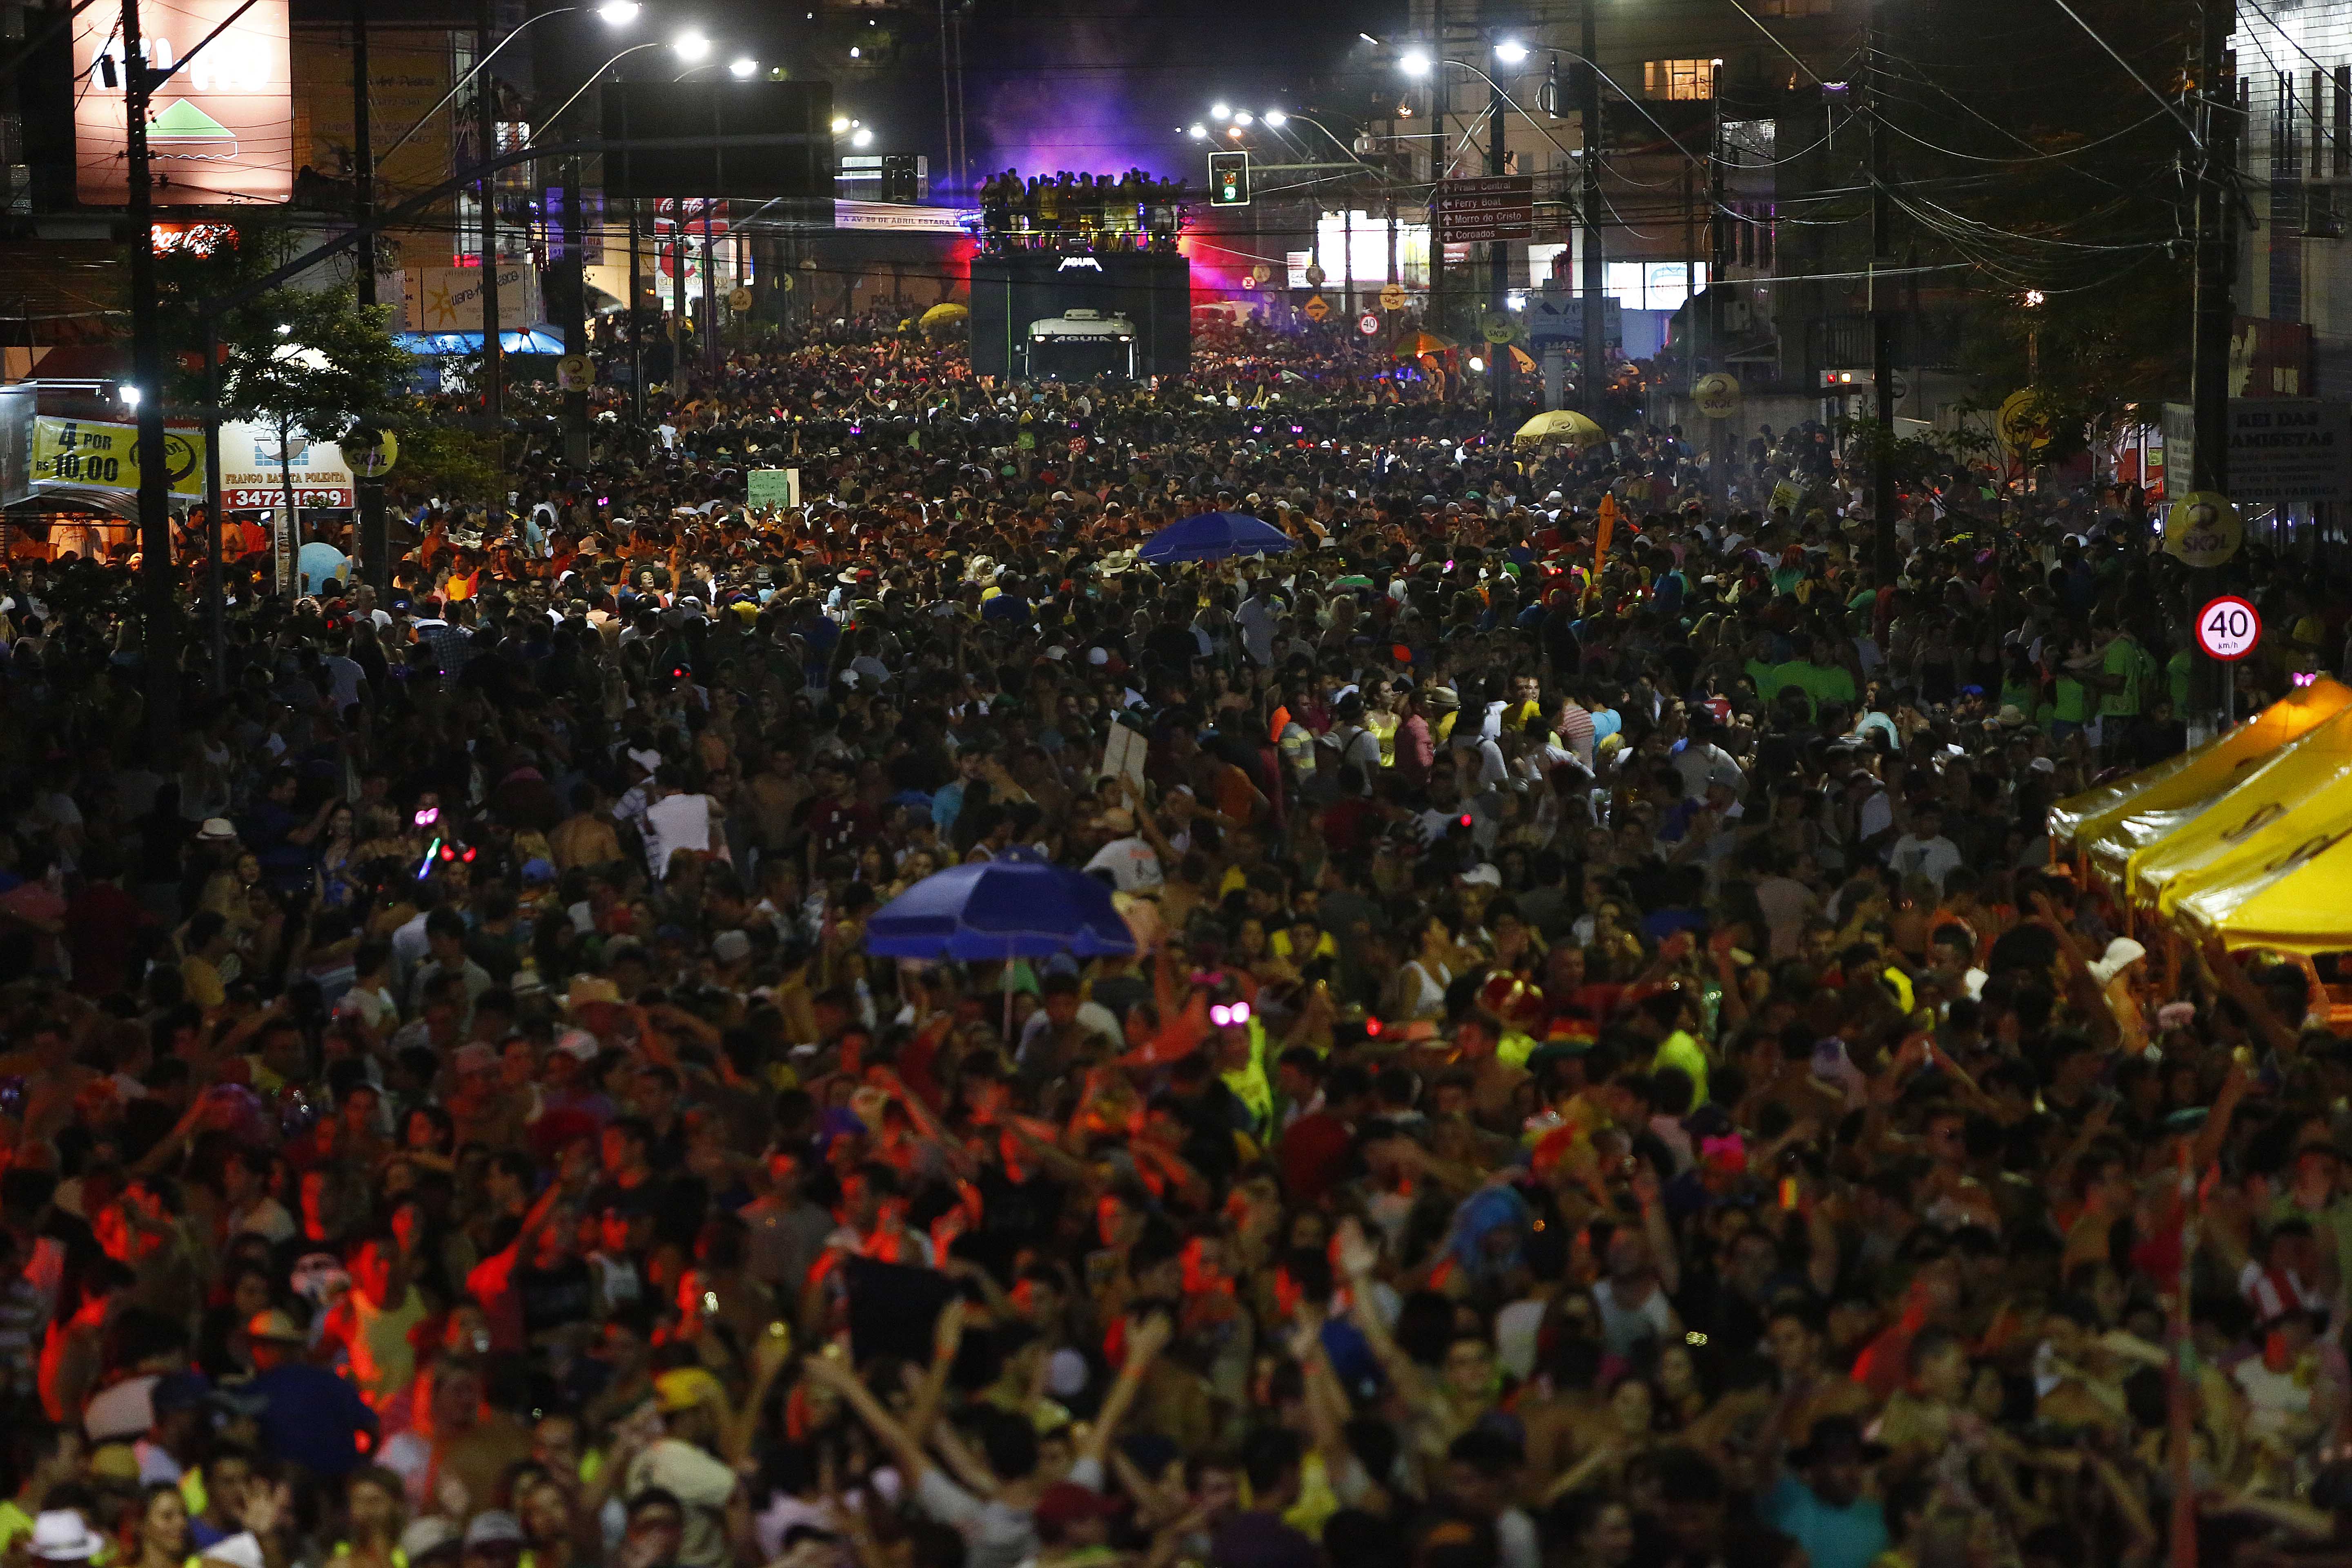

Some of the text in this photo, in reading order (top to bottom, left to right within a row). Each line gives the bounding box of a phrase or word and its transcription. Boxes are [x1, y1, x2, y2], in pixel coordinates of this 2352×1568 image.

[1481, 181, 1510, 190] Central
[1455, 198, 1501, 208] Ferry Boat
[1455, 212, 1522, 224] Morro do Cristo
[1456, 230, 1495, 240] Coroados
[1363, 318, 1375, 328] 40
[1704, 399, 1733, 409] SKOL
[58, 422, 113, 451] 4 POR
[2227, 432, 2335, 448] AMISETAS
[350, 453, 388, 466] SKOL
[53, 453, 118, 482] 10,00
[225, 471, 347, 484] FRANGO BATTA POLENTA
[2182, 534, 2227, 553] SKOL
[2208, 609, 2248, 638] 40
[2218, 641, 2238, 649] km/h
